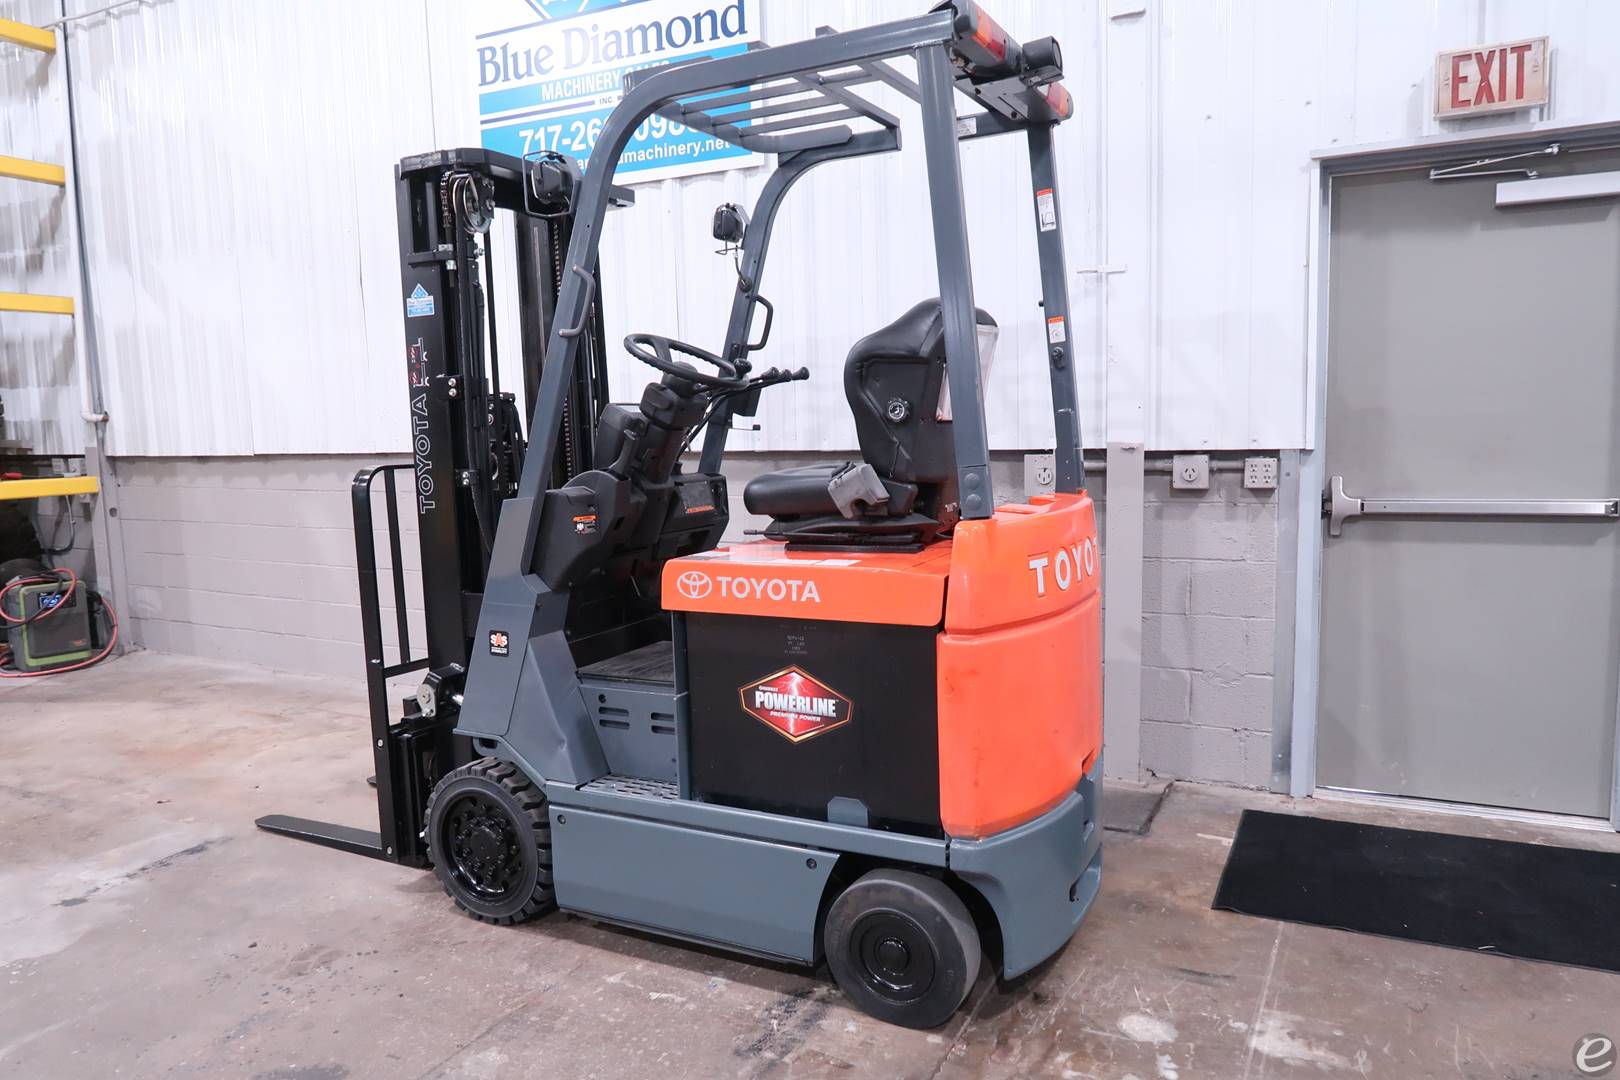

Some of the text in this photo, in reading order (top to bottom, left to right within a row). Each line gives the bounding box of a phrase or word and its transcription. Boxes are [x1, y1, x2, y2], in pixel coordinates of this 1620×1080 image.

[477, 0, 749, 87] Blue Diamond
[540, 69, 621, 102] MACHINERY
[1451, 44, 1532, 109] EXIT
[411, 393, 436, 514] TOYOTA
[1028, 536, 1099, 594] TOYO
[716, 576, 821, 603] TOYOTA
[490, 632, 508, 648] SAS
[755, 690, 837, 718] POWERLINE
[799, 714, 821, 722] POWER
